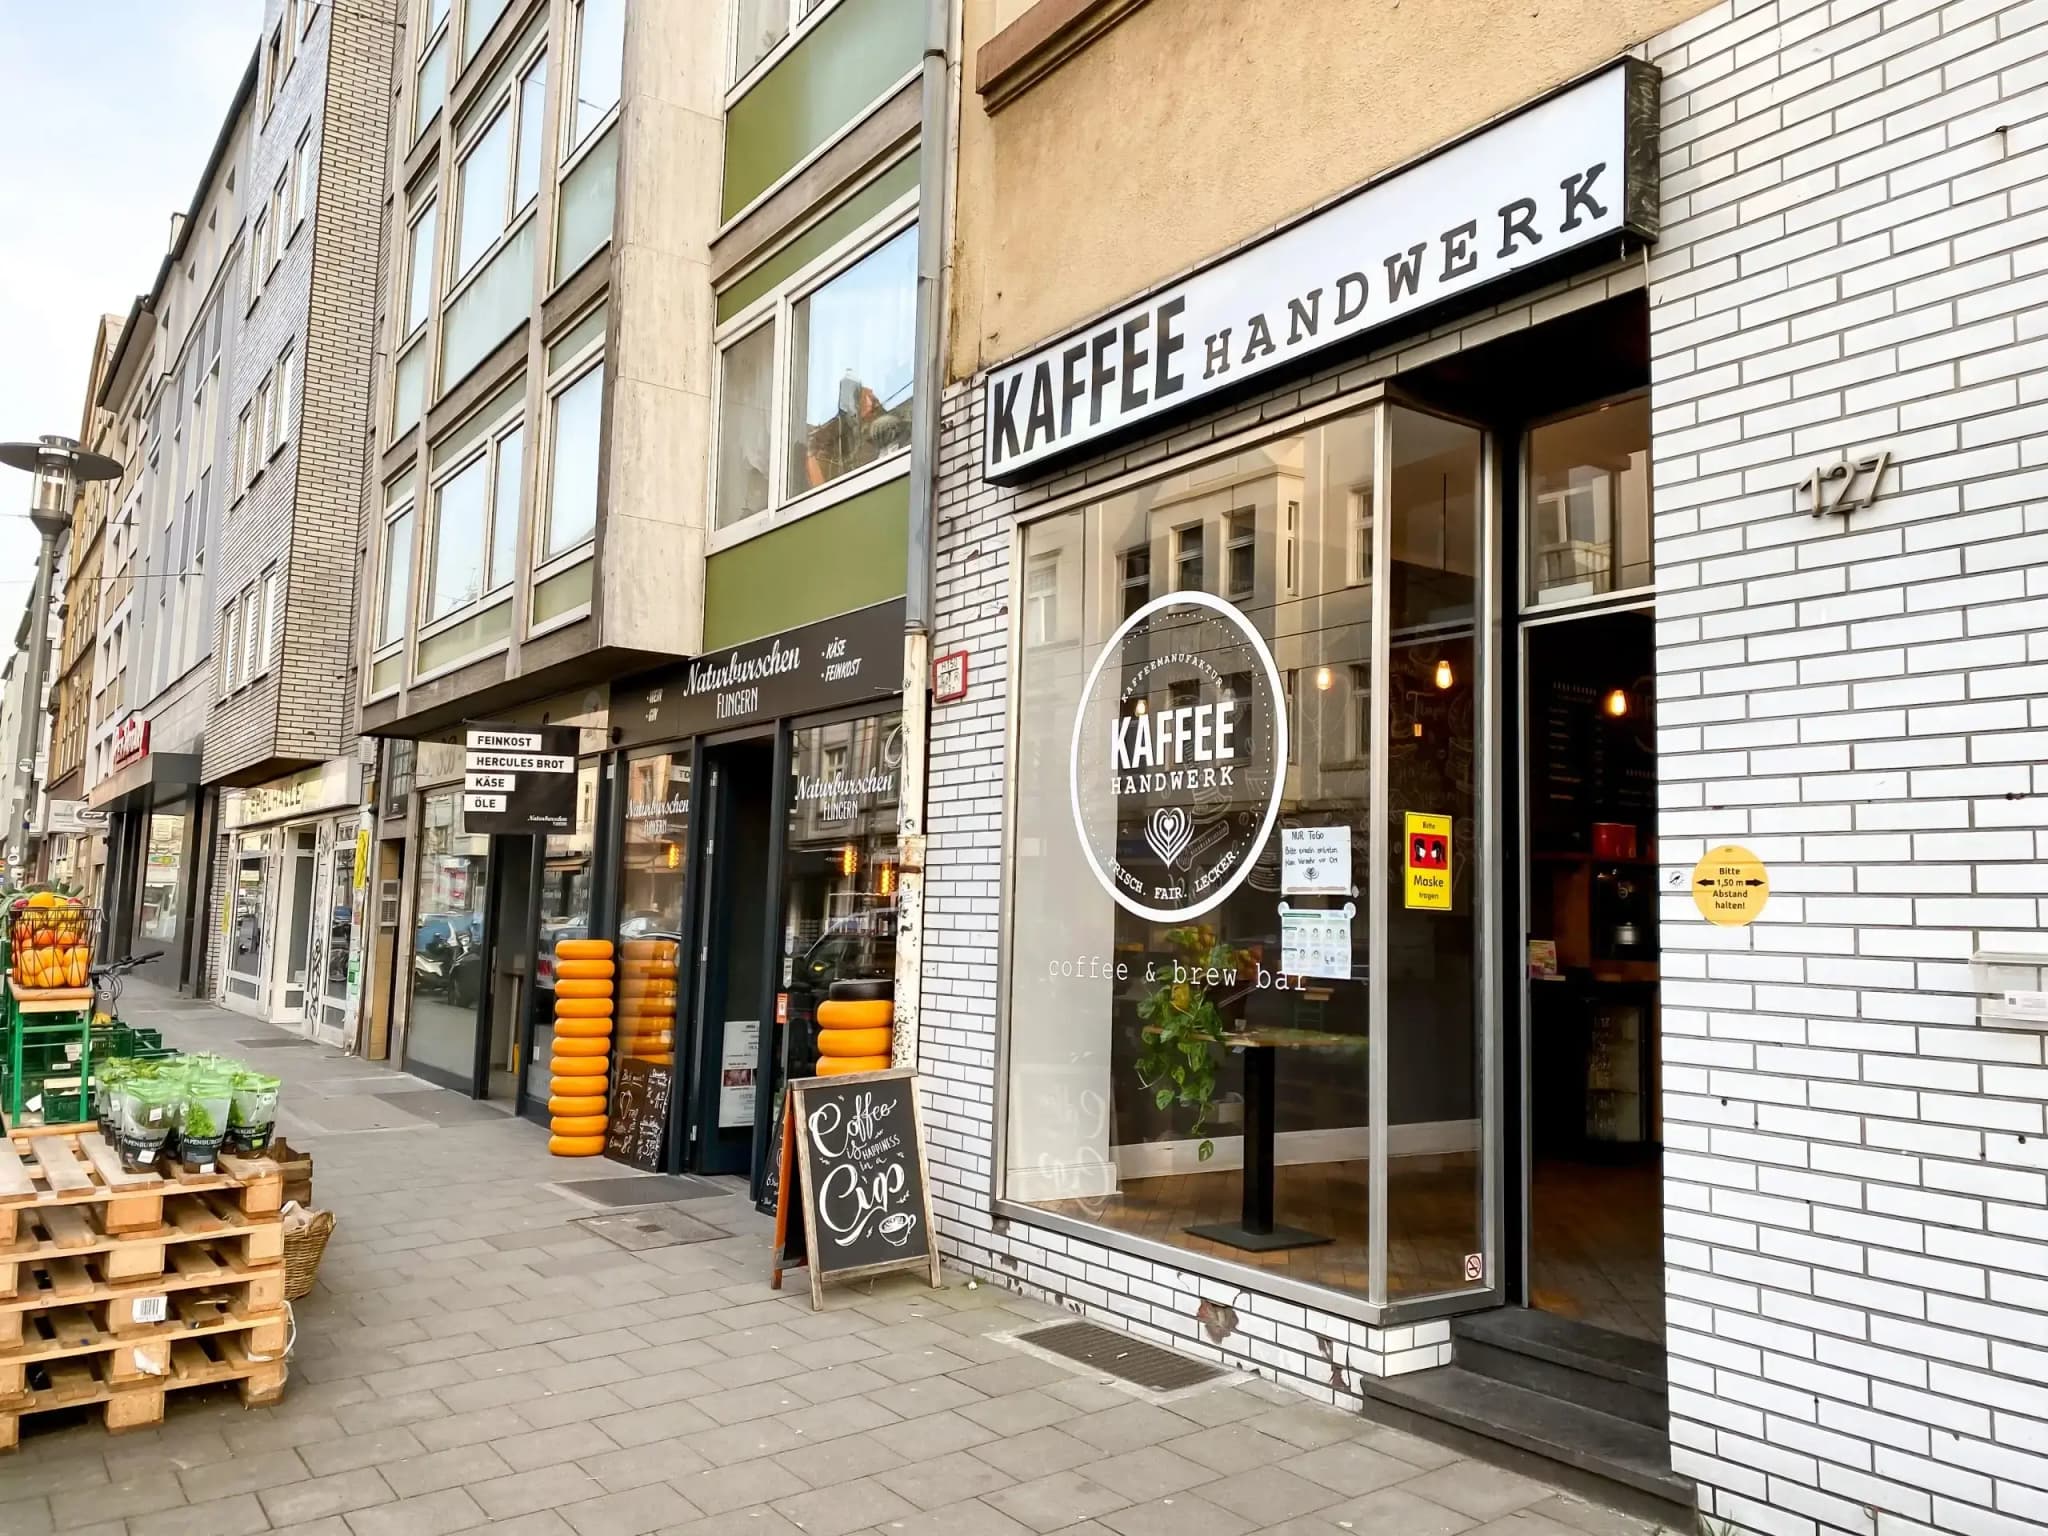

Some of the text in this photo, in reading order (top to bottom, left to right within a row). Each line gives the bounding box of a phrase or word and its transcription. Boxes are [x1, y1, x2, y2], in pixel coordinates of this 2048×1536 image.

[992, 162, 1608, 464] KAFFEE HANDWERK
[1800, 452, 1891, 518] 127
[825, 637, 847, 659] KÄSE
[683, 639, 801, 697] Naturburschen
[825, 658, 863, 682] FEINKOST
[1121, 652, 1224, 704] KAFFEEMANUFAKTUR
[716, 687, 759, 720] FLINGERN
[477, 735, 532, 747] FEINKOST
[1111, 701, 1235, 770] KAFFEE
[476, 756, 565, 769] HERCULES BROT
[475, 775, 505, 788] KÄSE
[794, 767, 893, 801] Naturburschen
[1110, 765, 1235, 795] HANDWERK
[474, 796, 496, 808] ÖLE
[625, 792, 690, 819] Naturburschen
[823, 800, 858, 821] FLINGERN
[1291, 831, 1304, 841] NUR
[1107, 850, 1240, 900] FRISCH. FAIR. LECKER.
[1413, 874, 1444, 888] Maske
[1717, 878, 1734, 887] 1,50
[1719, 867, 1741, 875] Bitte
[1418, 891, 1439, 901] tragen
[1712, 890, 1748, 898] Abstand
[1715, 901, 1745, 910] halten!
[1048, 955, 1307, 992] coffee & brew bar
[808, 1091, 897, 1158] Coffee
[861, 1134, 901, 1160] HAPPINESS
[819, 1163, 905, 1247] Cup
